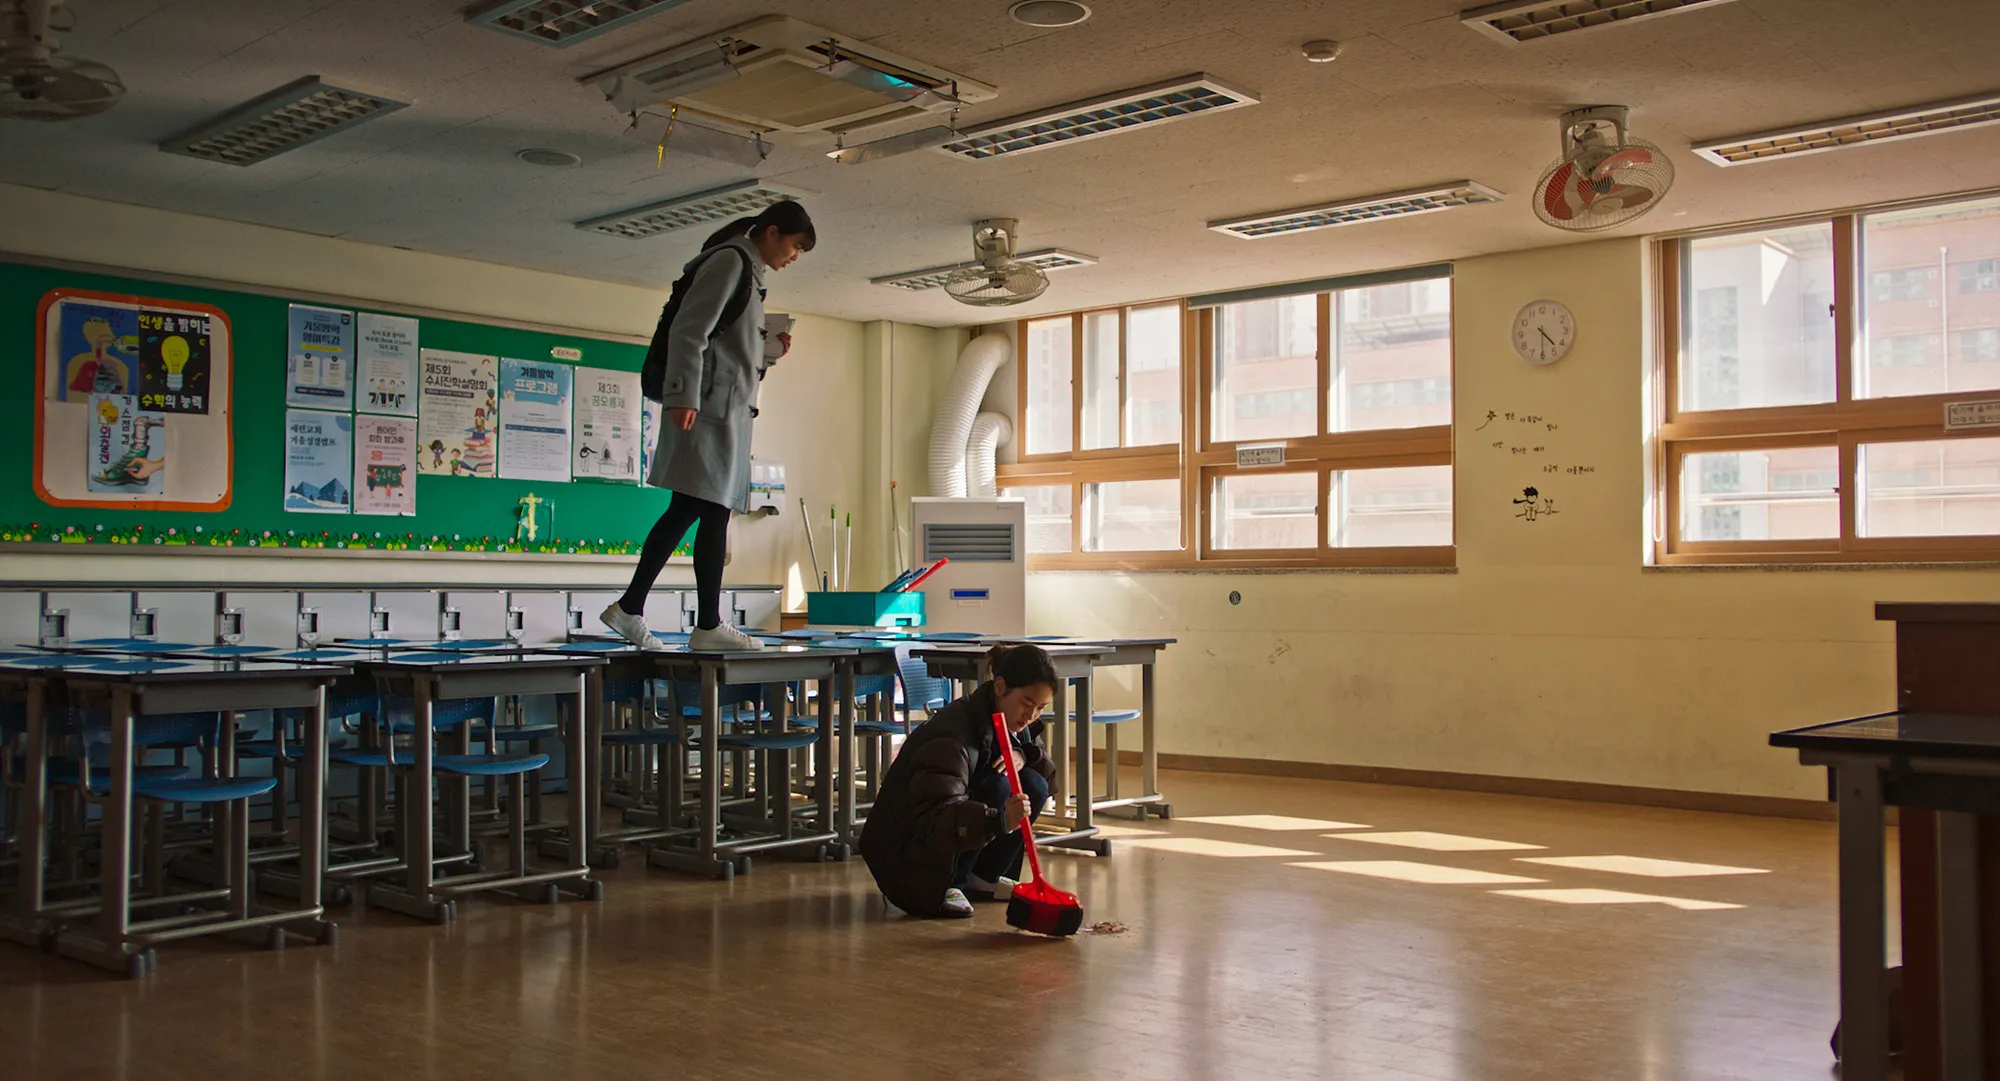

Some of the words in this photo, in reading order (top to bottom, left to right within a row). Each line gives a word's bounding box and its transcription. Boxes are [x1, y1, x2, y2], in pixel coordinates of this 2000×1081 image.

[138, 315, 175, 332] 인생을
[178, 317, 211, 335] 밝히는
[425, 363, 451, 376] 제5회
[521, 367, 555, 380] 겨울방학
[425, 375, 488, 391] 수시진학설명회
[514, 379, 558, 396] 프로그램
[597, 382, 620, 395] 제3회
[142, 395, 176, 408] 수학의
[181, 396, 202, 409] 능력
